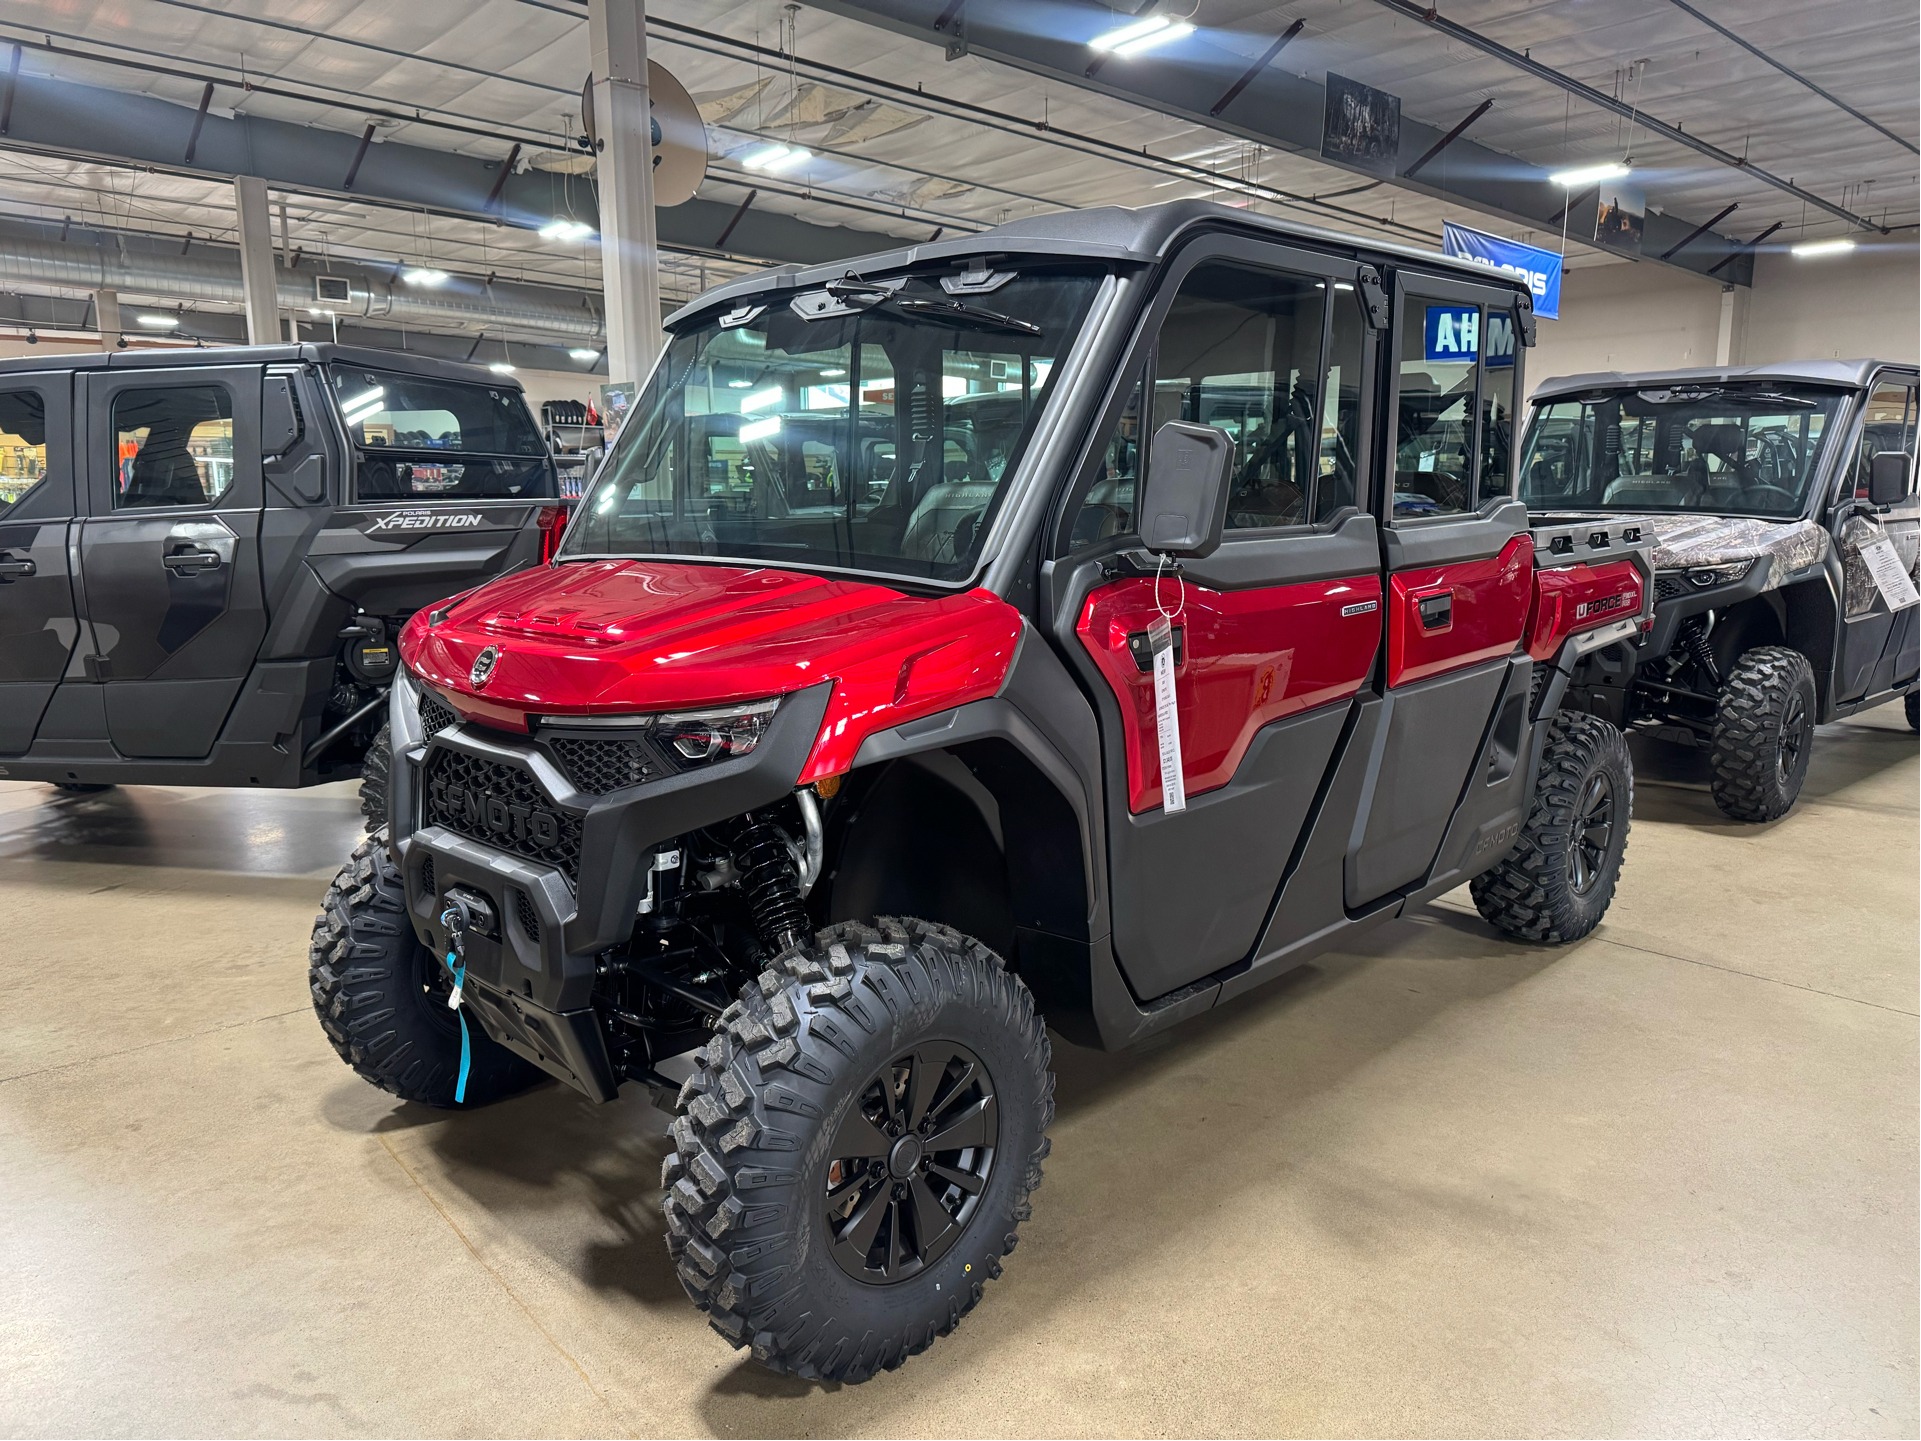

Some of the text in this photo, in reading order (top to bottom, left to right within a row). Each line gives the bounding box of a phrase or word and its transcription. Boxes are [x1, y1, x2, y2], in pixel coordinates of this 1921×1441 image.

[364, 512, 483, 534] XPEDITION
[1344, 603, 1376, 614] HIGHLAND
[1576, 594, 1621, 619] UFORCE
[432, 778, 559, 848] CFMOTO
[1476, 822, 1519, 855] CFMOTO
